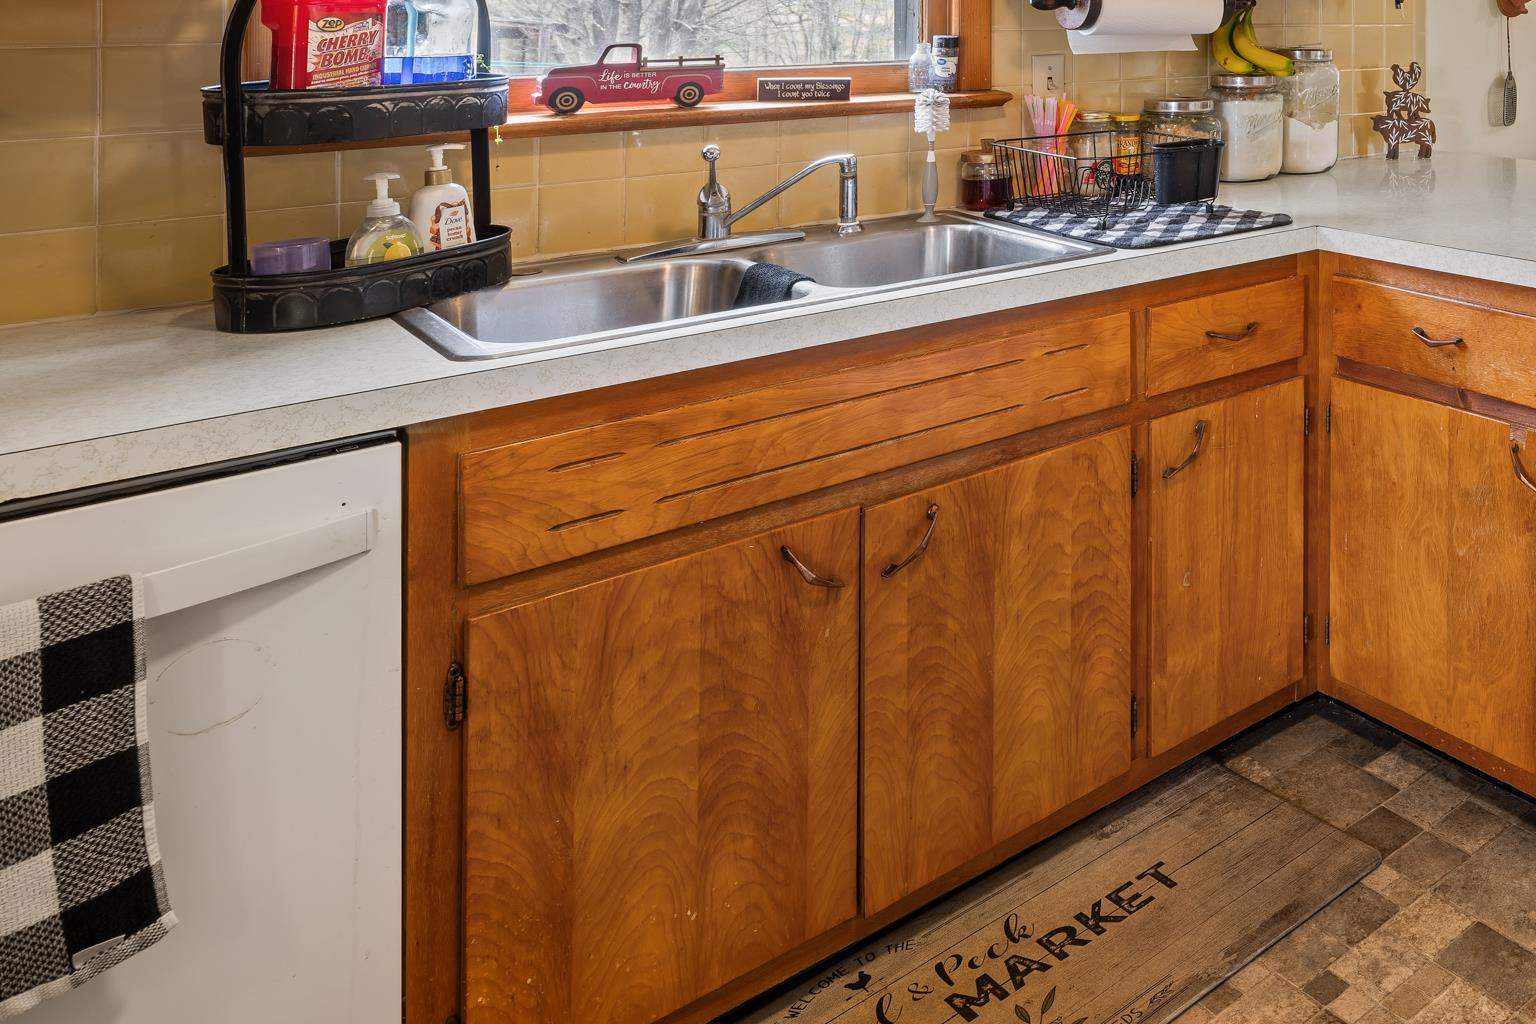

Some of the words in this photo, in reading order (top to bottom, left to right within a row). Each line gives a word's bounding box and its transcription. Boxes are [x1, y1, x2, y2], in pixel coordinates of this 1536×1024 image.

[317, 29, 379, 53] CHERRY
[320, 47, 369, 68] BOMB
[598, 68, 622, 84] Life
[623, 79, 661, 93] country
[764, 81, 780, 90] When
[786, 82, 803, 90] count
[805, 83, 815, 91] my
[816, 81, 846, 92] Blessings
[801, 91, 813, 99] you
[444, 216, 463, 225] Dove
[943, 860, 1178, 1023] MARKET
[784, 966, 850, 1020] WELCOME
[853, 952, 876, 966] TO
[884, 938, 915, 954] THE
